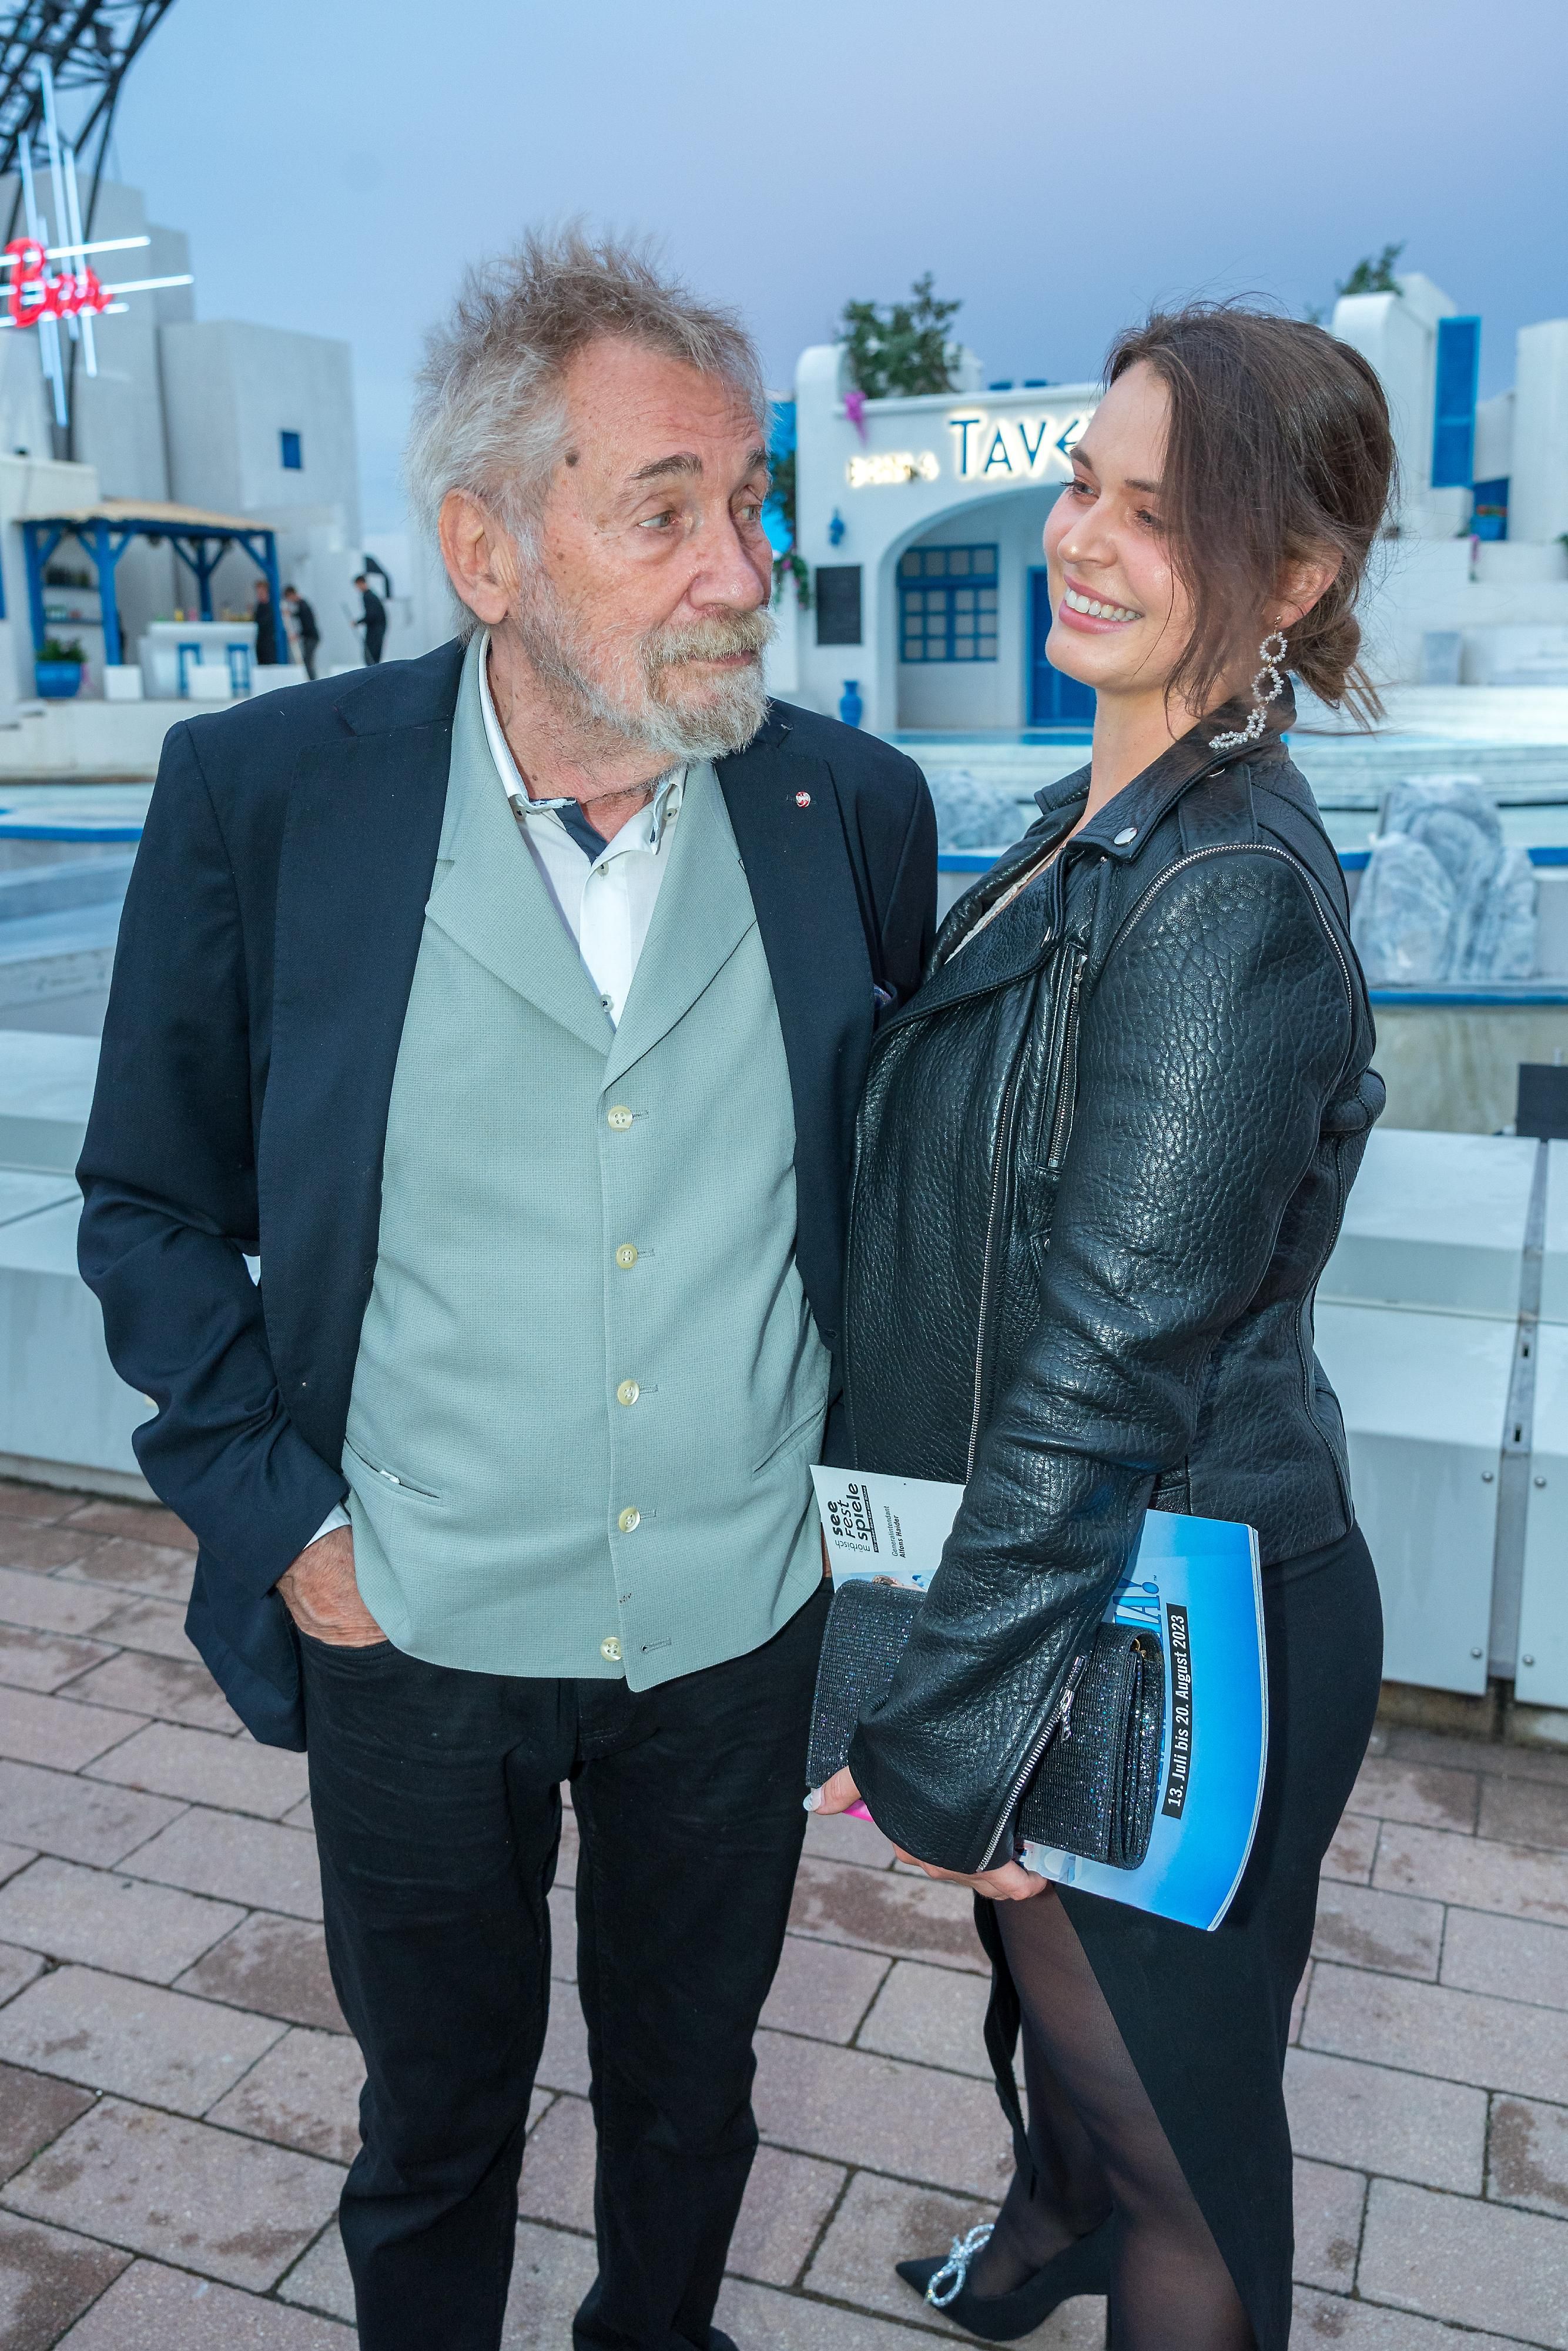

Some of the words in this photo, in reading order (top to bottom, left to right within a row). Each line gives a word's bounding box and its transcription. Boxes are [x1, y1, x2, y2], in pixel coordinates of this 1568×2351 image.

[5, 237, 113, 328] Bar
[827, 1501, 843, 1536] see
[837, 1499, 856, 1539] Fest
[846, 1483, 871, 1540] spiele
[835, 1540, 870, 1552] mörbisch
[884, 1506, 898, 1556] Generalintendant
[1170, 1615, 1187, 1649] 2023
[1175, 1651, 1191, 1700] August
[1175, 1704, 1190, 1725] 20.
[1174, 1728, 1189, 1751] bis
[1172, 1753, 1187, 1781] Juli
[1168, 1784, 1184, 1807] 13.
